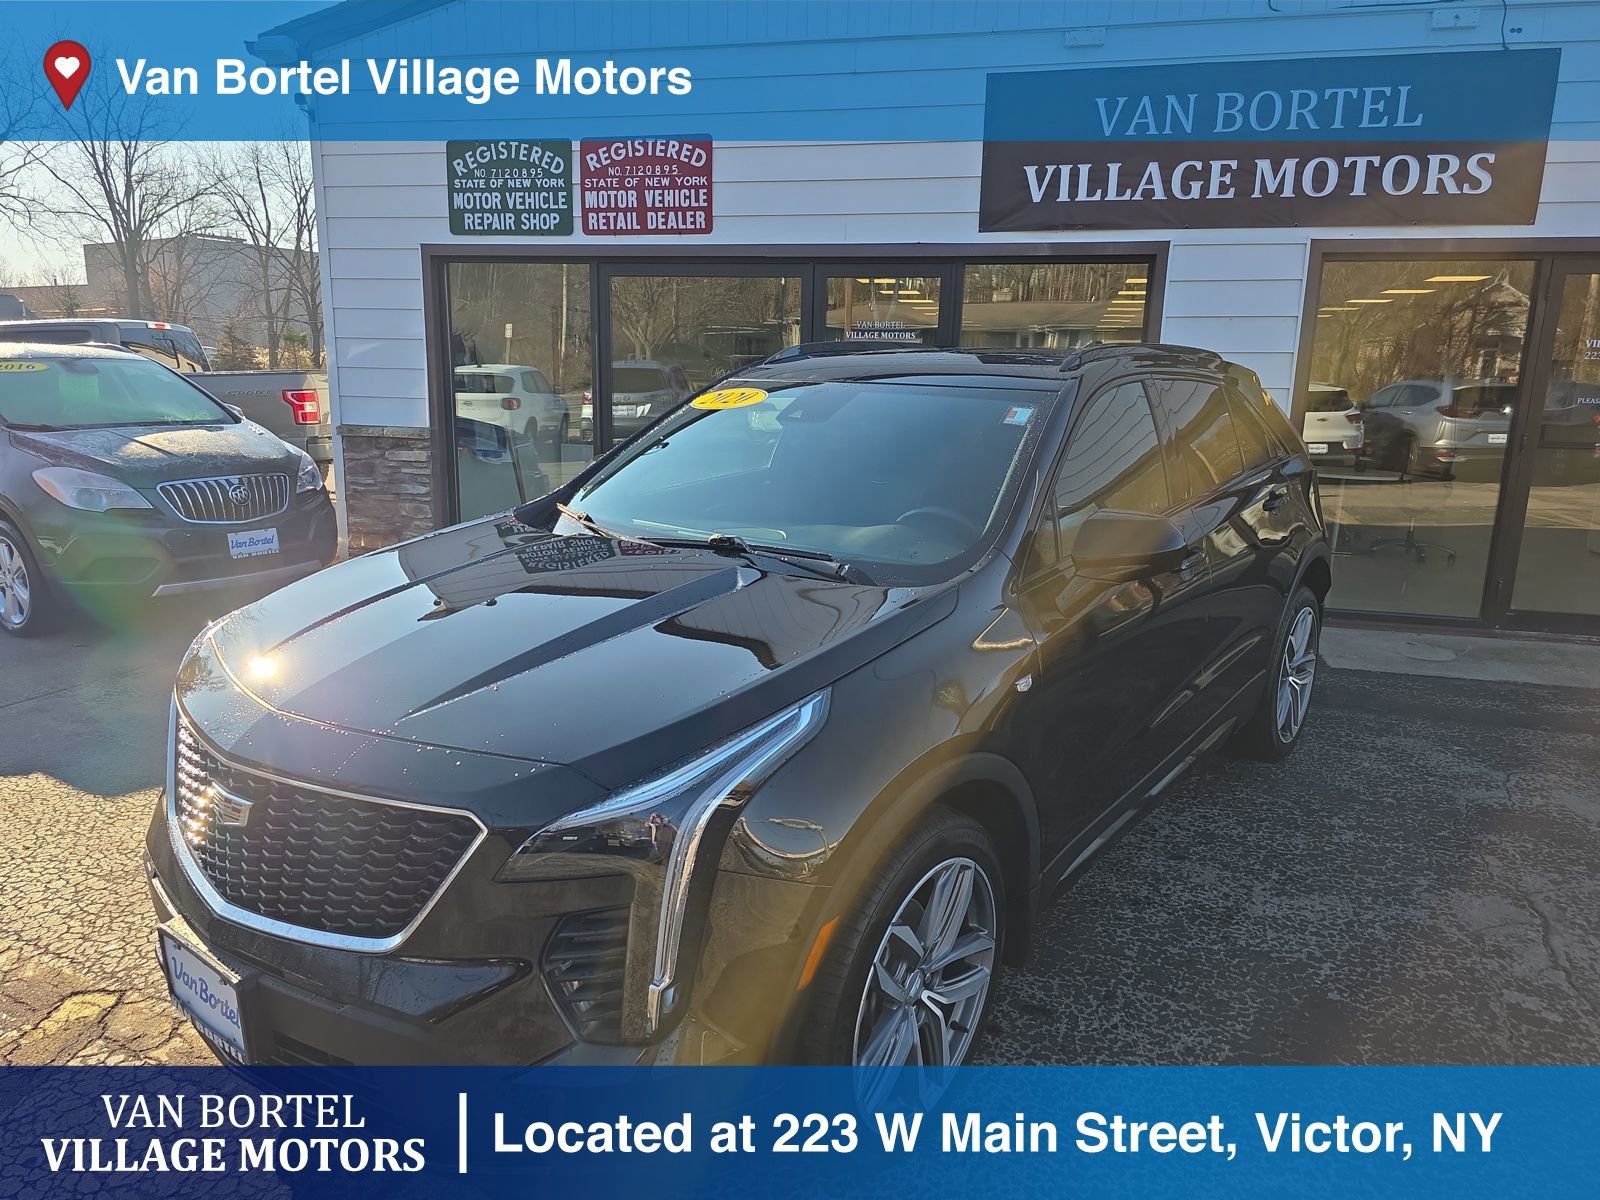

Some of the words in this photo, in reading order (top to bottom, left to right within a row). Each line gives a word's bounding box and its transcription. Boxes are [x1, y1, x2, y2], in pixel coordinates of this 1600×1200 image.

[1095, 93, 1198, 136] VAN
[1213, 85, 1424, 133] BORTEL
[453, 141, 565, 177] REGISTERED
[585, 138, 707, 172] REGISTERED
[474, 168, 487, 178] NO.
[491, 167, 543, 178] 7120895
[608, 166, 622, 176] NO.
[625, 164, 679, 175] 7120895
[1024, 159, 1238, 203] VILLAGE
[1250, 153, 1496, 198] MOTORS
[454, 179, 486, 188] STATE
[489, 179, 504, 188] OF
[507, 179, 531, 188] NEW
[535, 178, 565, 188] YORK
[584, 178, 620, 188] STATE
[624, 177, 640, 188] OF
[645, 177, 670, 187] NEW
[675, 176, 708, 186] YORK
[453, 191, 502, 210] MOTOR
[505, 191, 568, 209] VEHICLE
[584, 190, 638, 209] MOTOR
[644, 188, 708, 208] VEHICLE
[464, 212, 515, 230] REPAIR
[520, 212, 560, 230] SHOP
[588, 211, 641, 230] RETAIL
[646, 210, 706, 229] DEALER
[856, 320, 873, 329] VAN
[875, 320, 905, 329] BORTEL
[846, 331, 879, 340] VILLAGE
[880, 331, 916, 340] MOTORS
